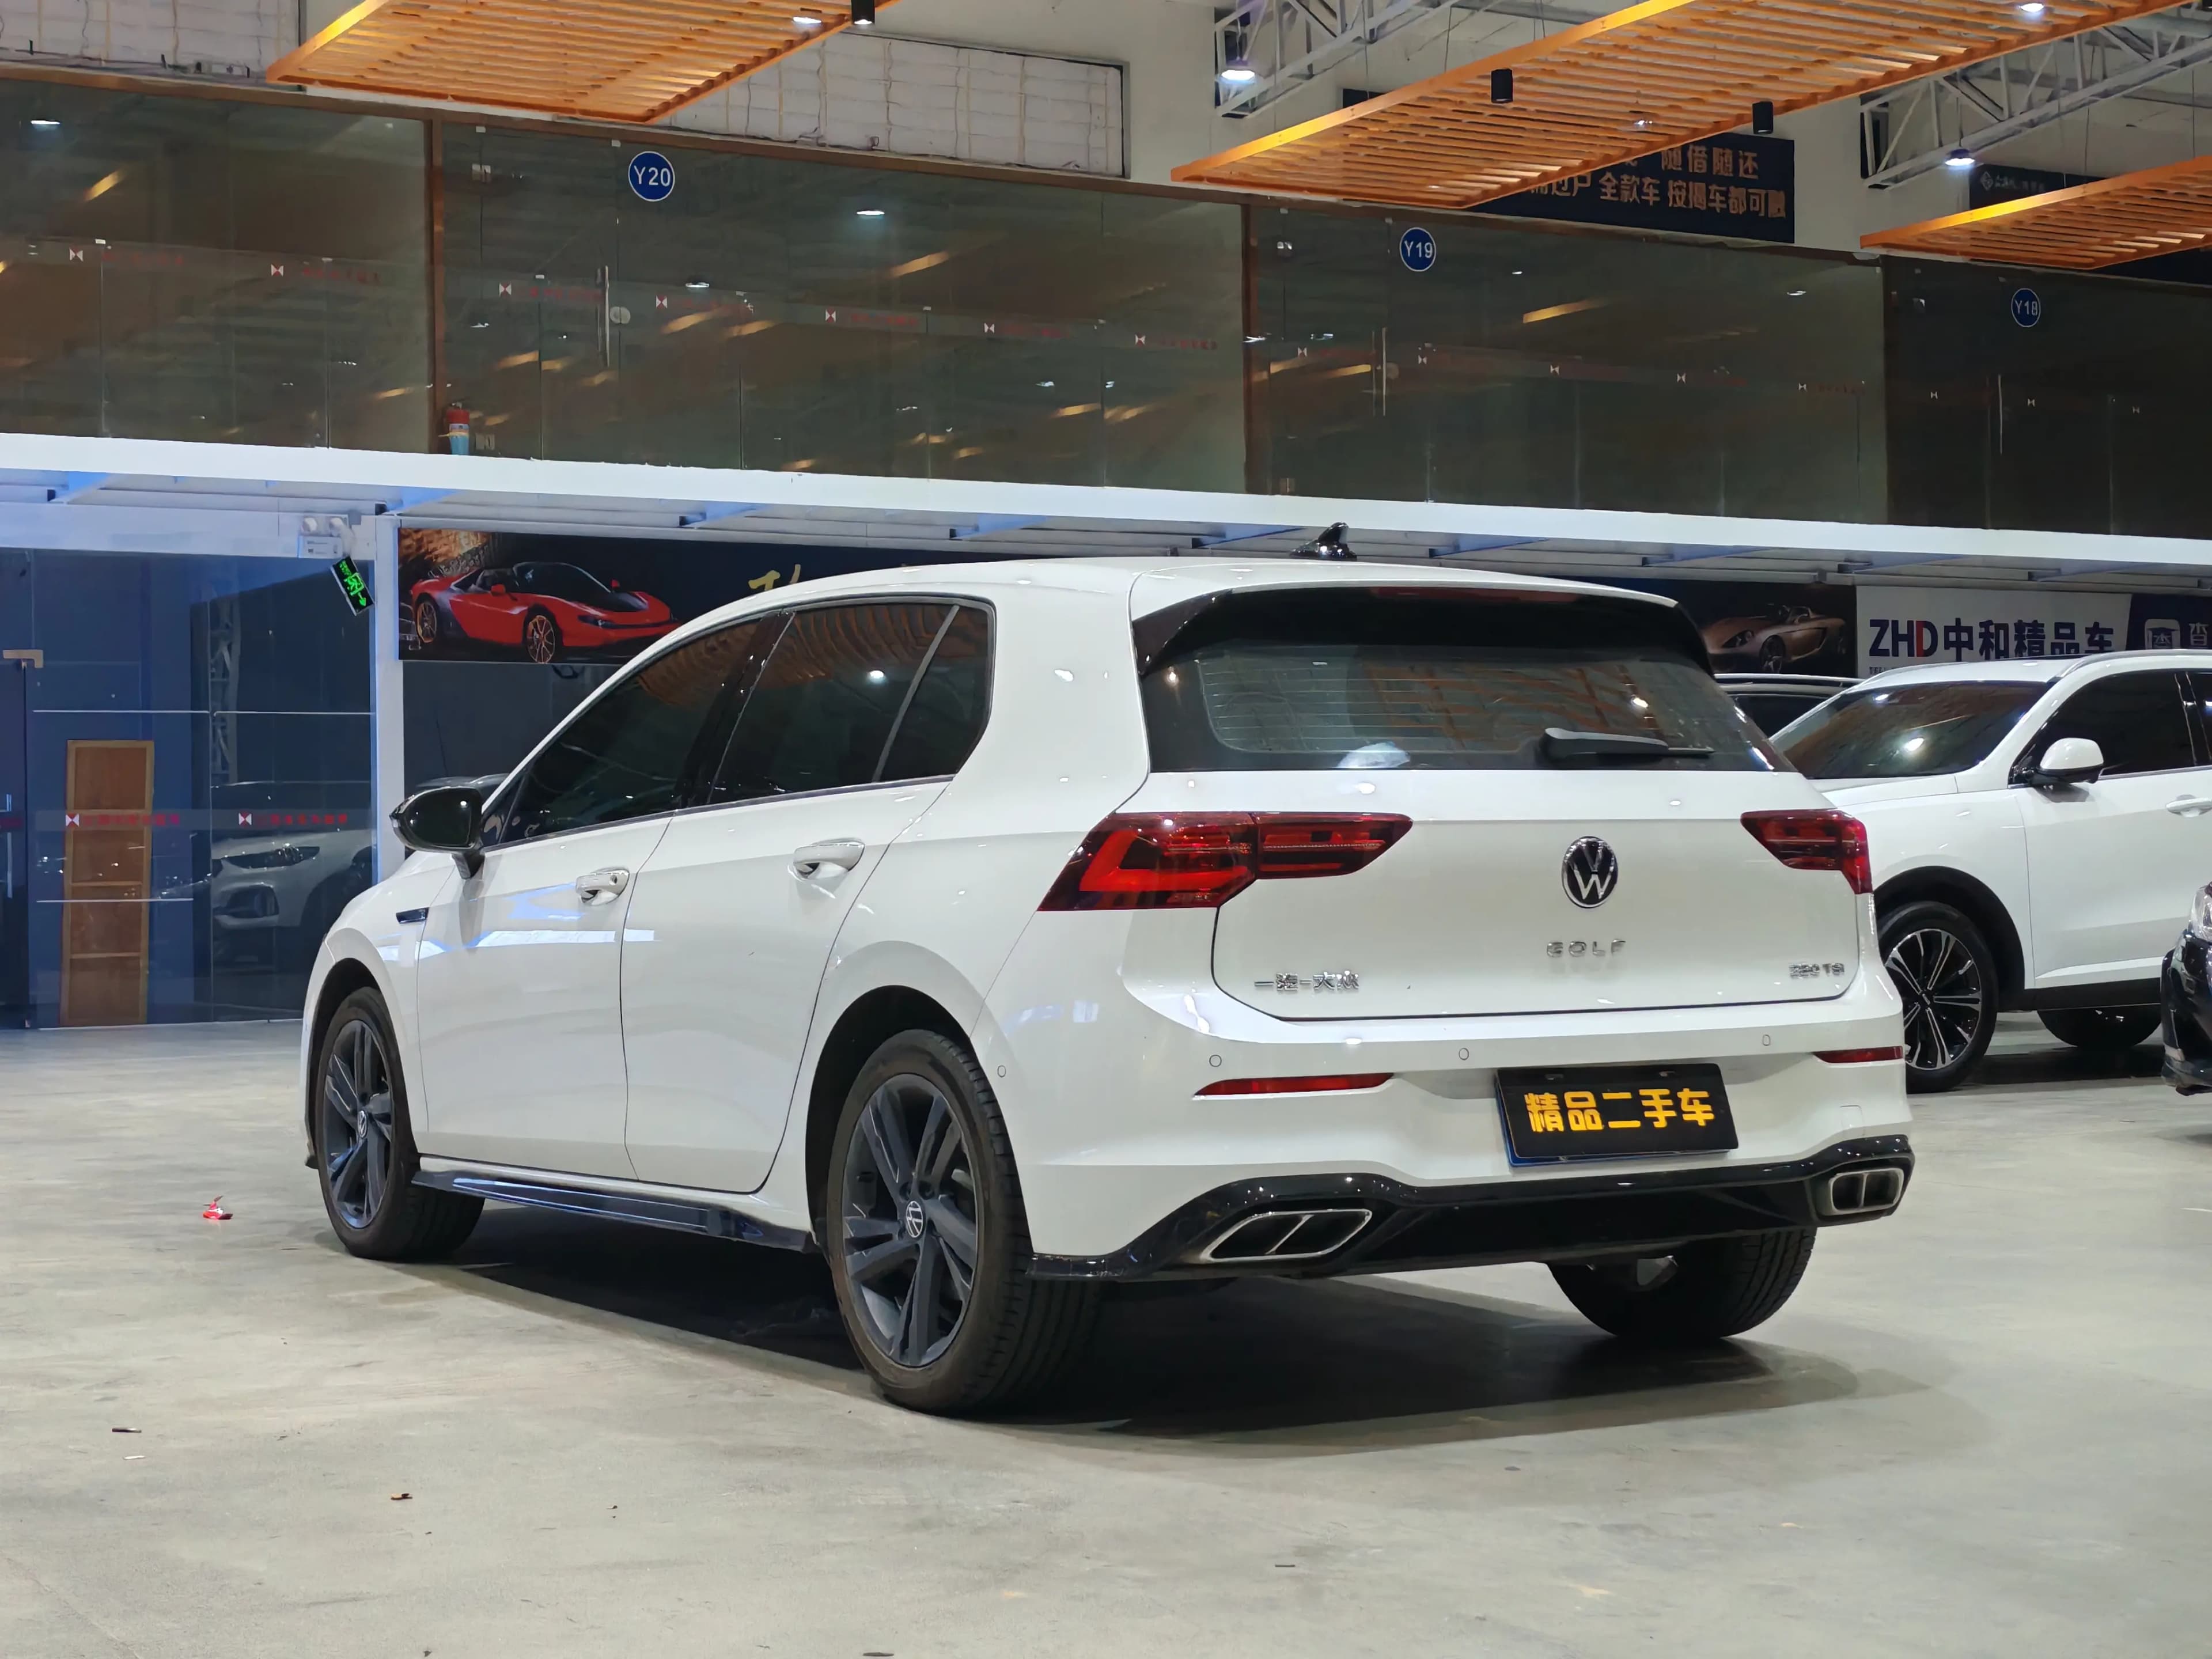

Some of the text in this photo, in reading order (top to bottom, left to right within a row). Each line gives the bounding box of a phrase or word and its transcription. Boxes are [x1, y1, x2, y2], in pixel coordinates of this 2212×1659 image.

[634, 165, 671, 187] Y20
[1599, 171, 1661, 206] 全款车
[1404, 240, 1433, 258] Y19
[2014, 300, 2038, 316] Y18
[1869, 618, 2115, 662] ZHD 中和精品车
[1547, 939, 1626, 957] GOLF
[1524, 1088, 1715, 1132] 精品二手车
